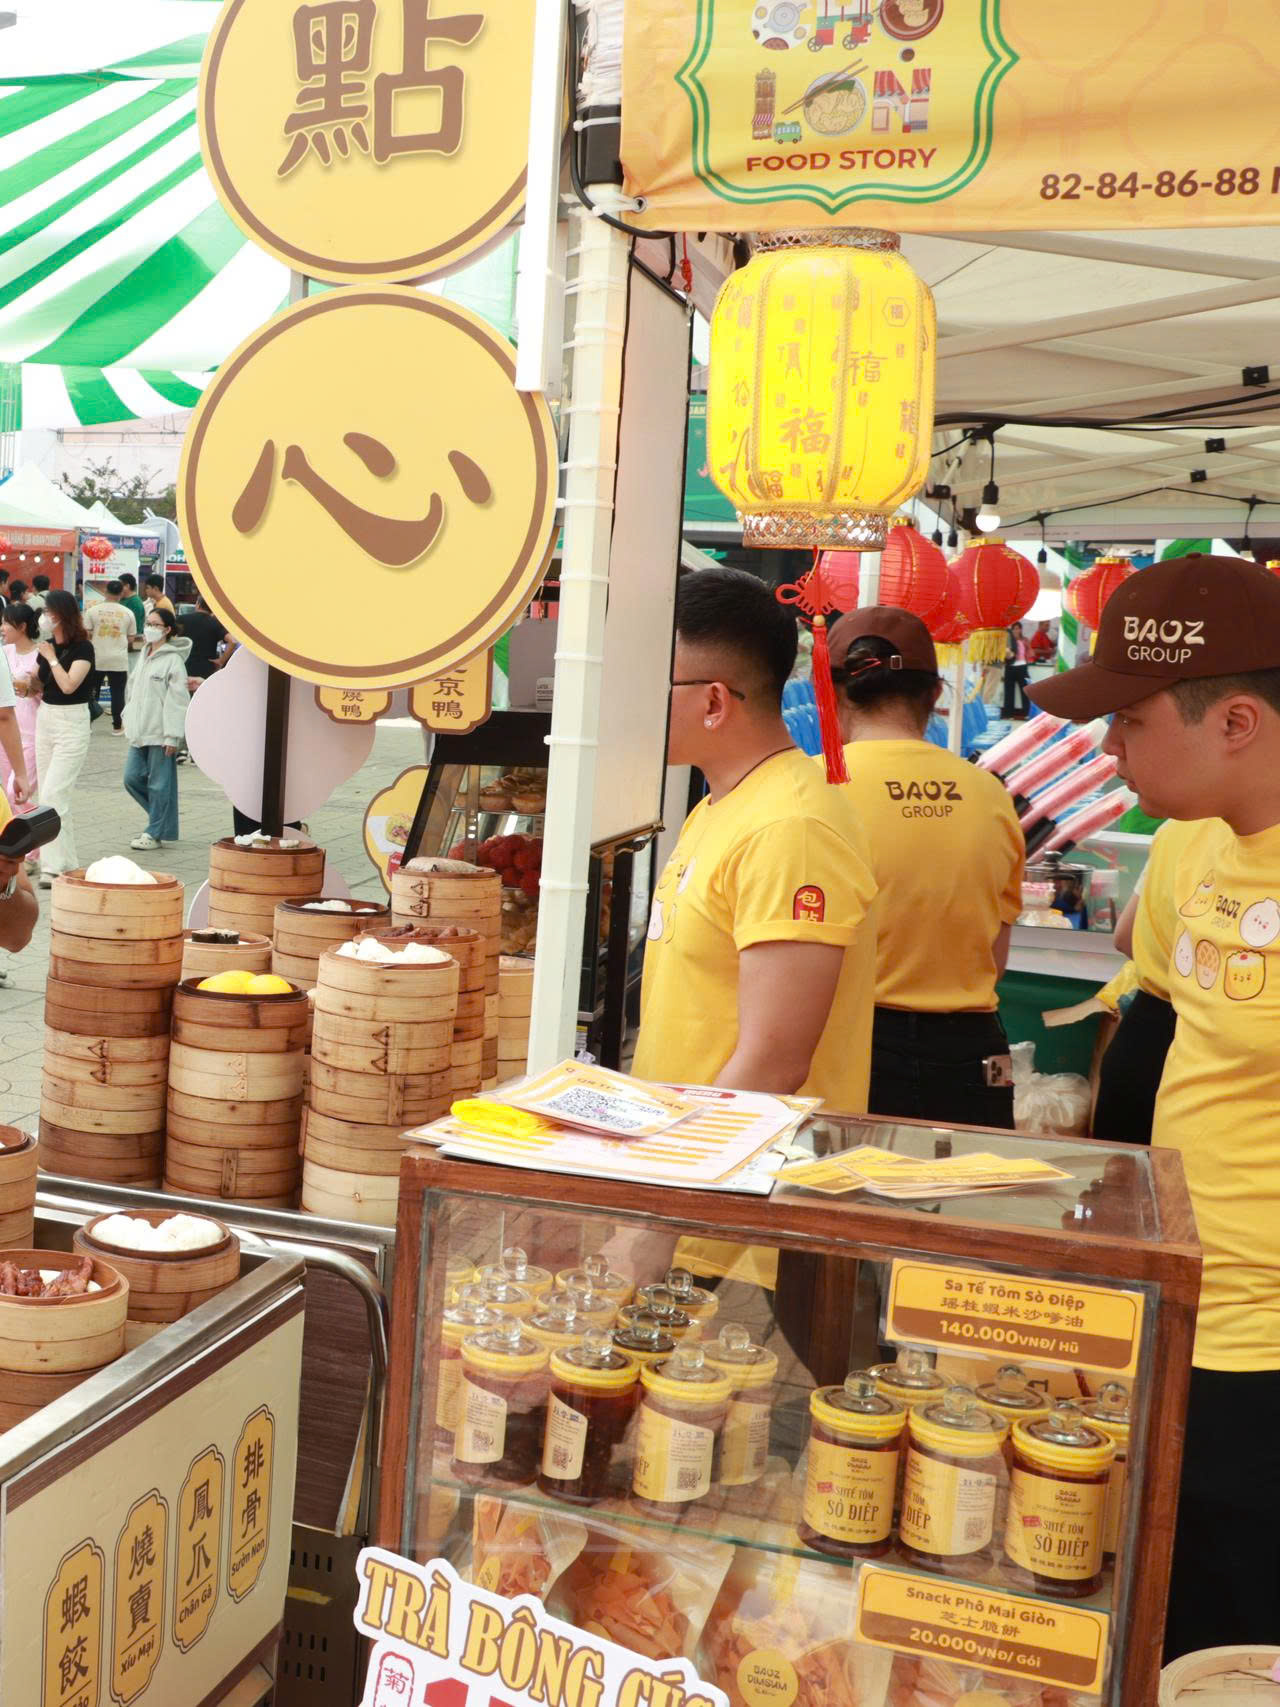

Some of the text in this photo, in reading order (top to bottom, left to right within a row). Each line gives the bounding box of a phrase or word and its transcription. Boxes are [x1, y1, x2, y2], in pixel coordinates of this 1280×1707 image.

[746, 148, 937, 172] FOOD STORY
[1039, 166, 1261, 201] 82-84-86-88
[231, 431, 493, 569] 心
[1124, 616, 1205, 645] BAOZ
[1127, 645, 1192, 663] GROUP
[885, 781, 963, 801] BAOZ
[901, 805, 953, 818] GROUP
[945, 1279, 1085, 1312] Sa Tế Tôm Sò Điệp
[242, 1437, 265, 1539] 排骨
[186, 1478, 214, 1586] 鳳爪
[251, 1539, 266, 1560] Non
[128, 1524, 157, 1639] 燒賣
[906, 1586, 1056, 1628] Snack Phô Mai Giòn
[362, 1556, 605, 1707] TRÀ BÔNG
[1016, 1652, 1041, 1668] Gói
